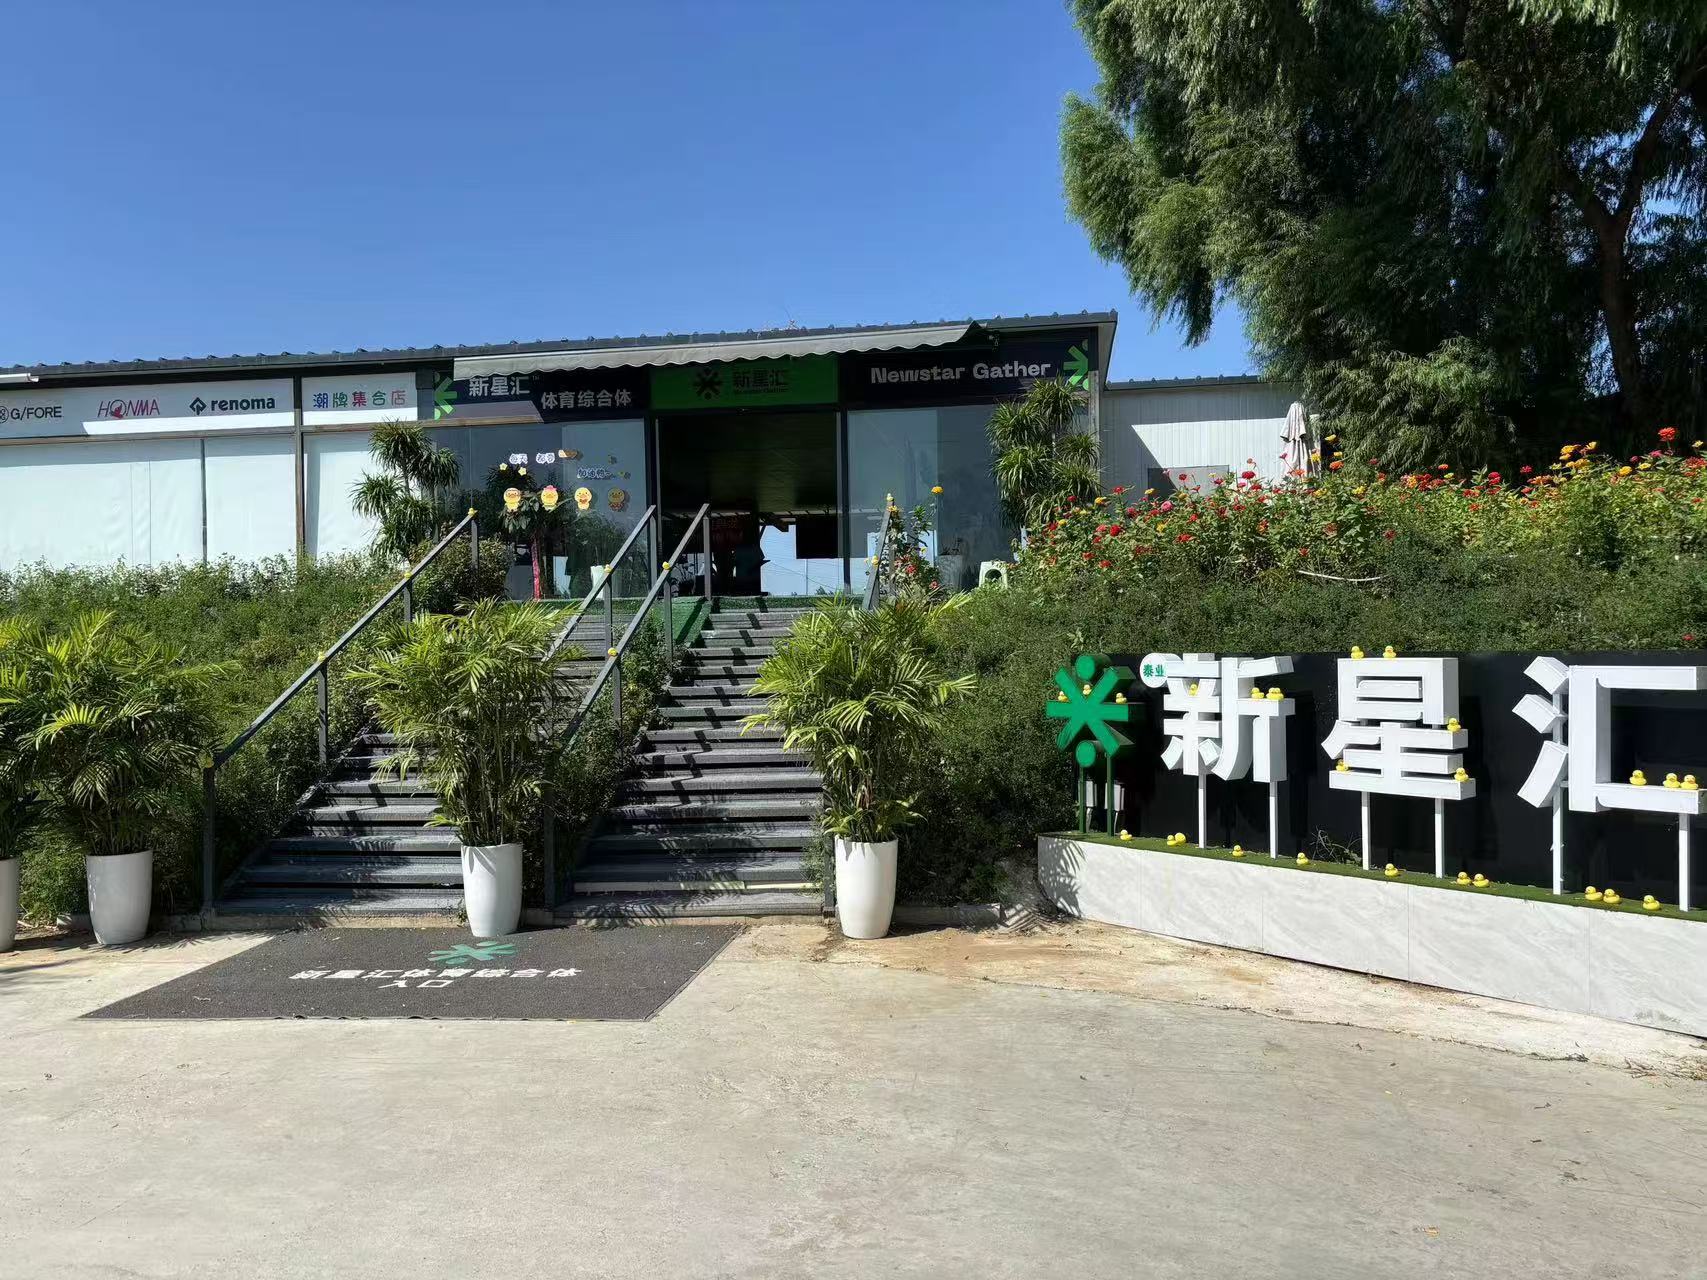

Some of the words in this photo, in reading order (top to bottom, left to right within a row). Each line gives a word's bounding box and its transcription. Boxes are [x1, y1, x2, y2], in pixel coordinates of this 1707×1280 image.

[733, 368, 790, 387] 新星汇
[870, 365, 965, 384] Newstar
[972, 360, 1051, 380] Gather
[468, 376, 531, 397] 新星汇
[97, 399, 160, 419] HONMA
[210, 397, 276, 413] renoma
[312, 390, 407, 409] 潮牌集合店
[540, 389, 632, 410] 体育综合体
[10, 405, 63, 421] G/FORE
[1143, 664, 1165, 677] 泰业
[1161, 652, 1700, 813] 新星汇
[289, 967, 582, 980] 新星汇体育综合体
[377, 979, 454, 988] 入口
